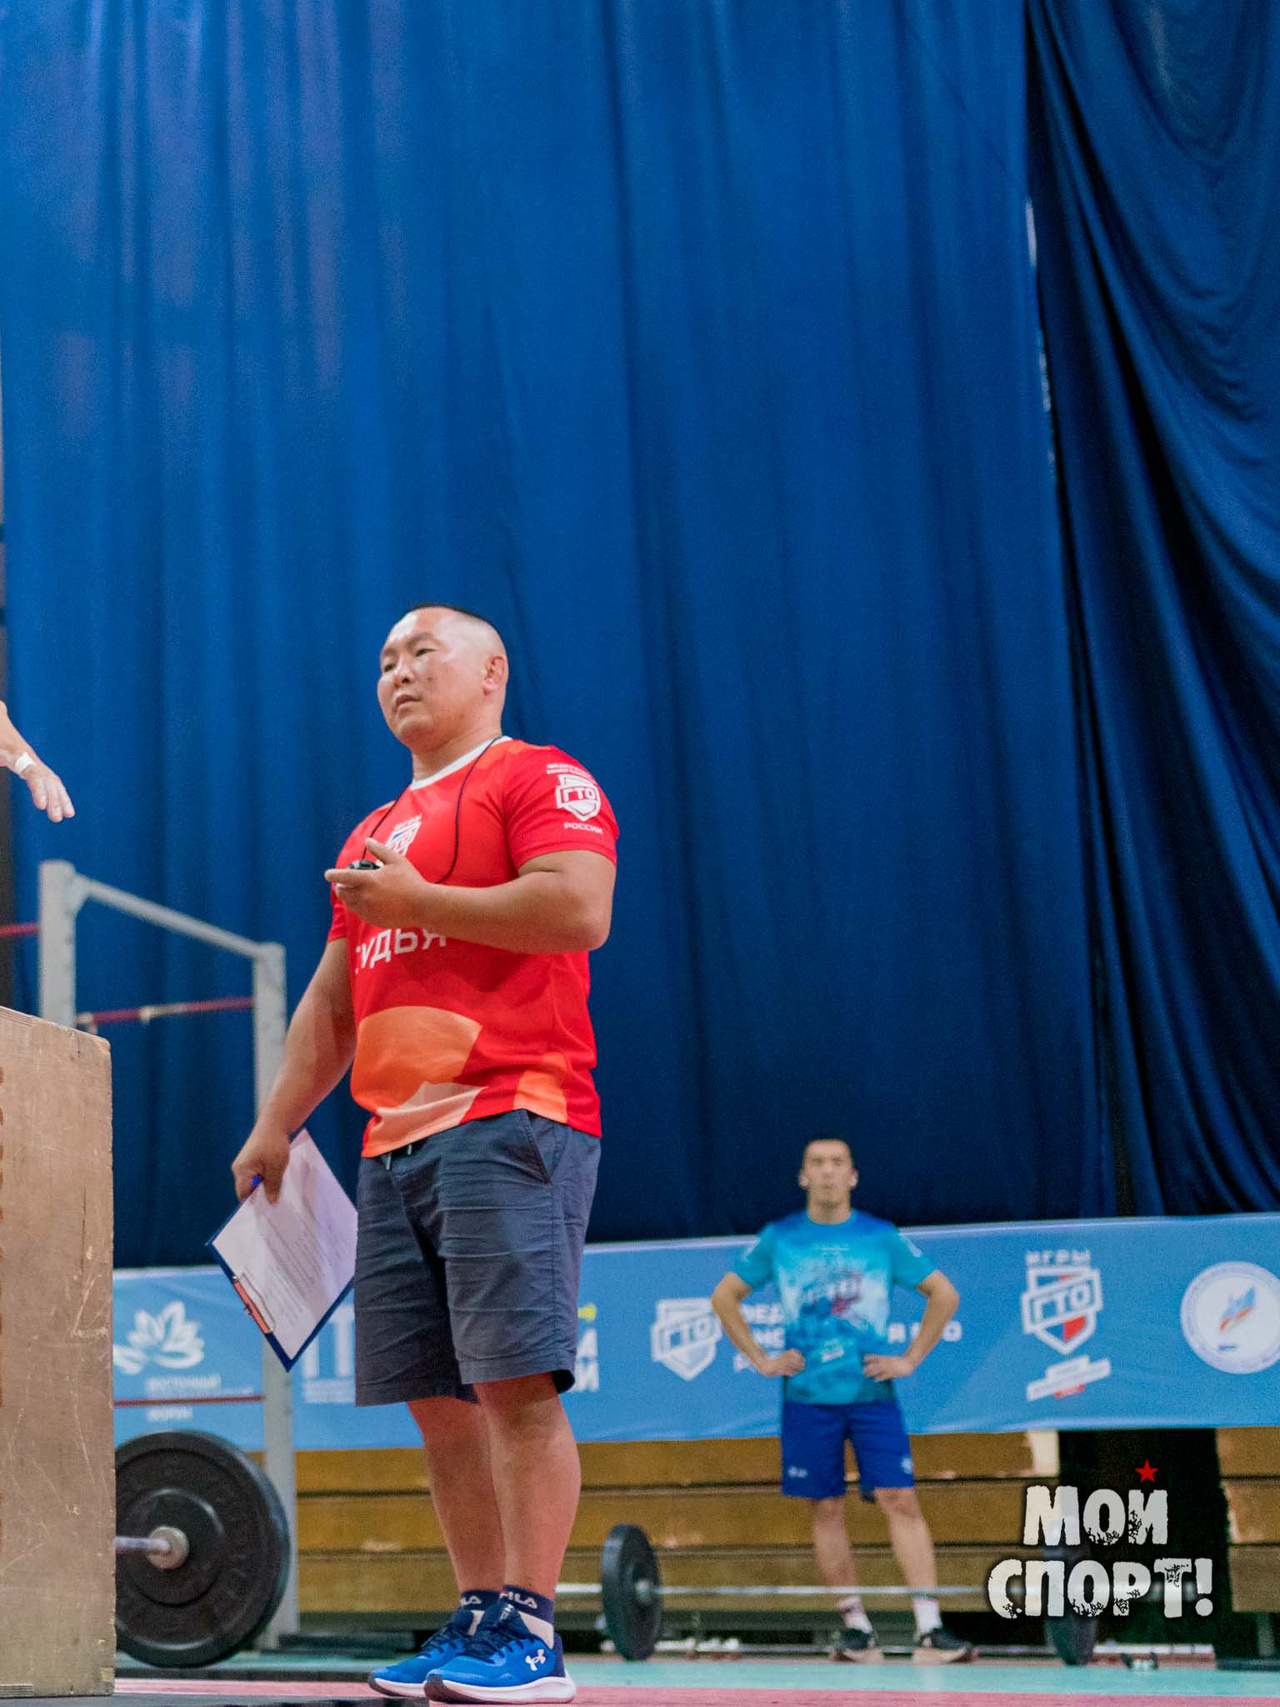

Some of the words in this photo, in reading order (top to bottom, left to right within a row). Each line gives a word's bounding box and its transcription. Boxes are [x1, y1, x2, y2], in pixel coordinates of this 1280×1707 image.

[562, 786, 596, 803] ГТО
[563, 821, 604, 835] РОССИИ
[1025, 1250, 1091, 1267] ИГРЫ
[1033, 1282, 1091, 1322] ГТО
[667, 1317, 712, 1351] ГТО
